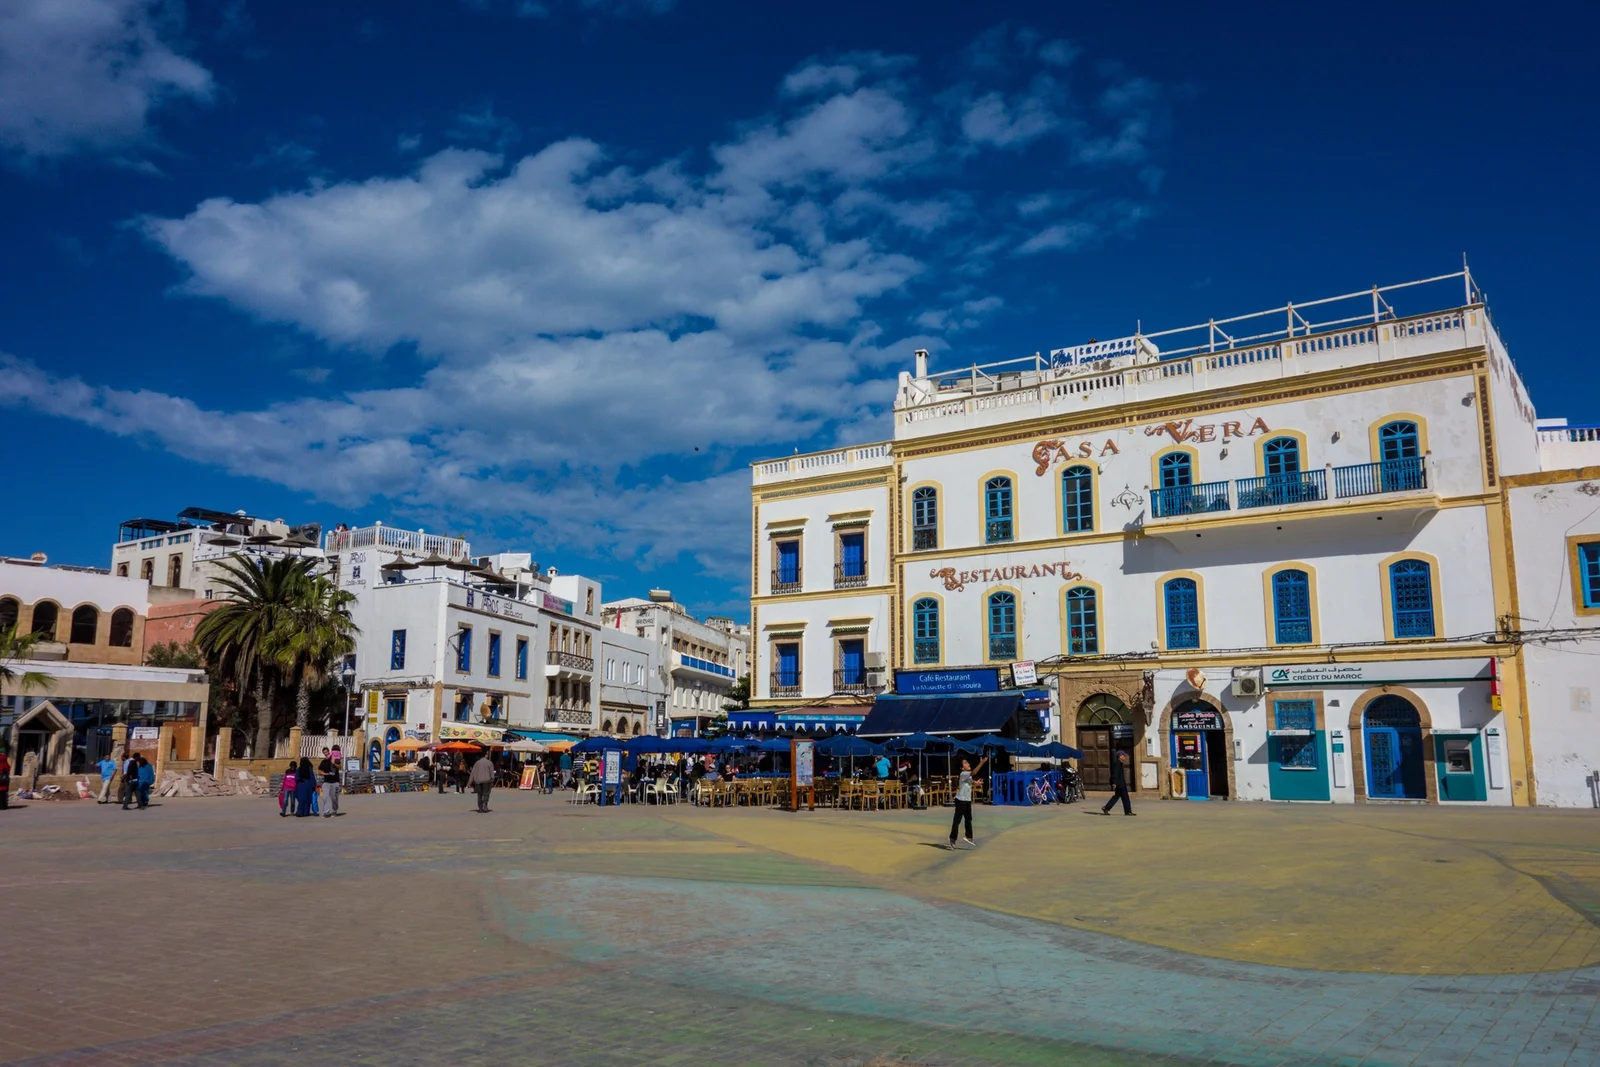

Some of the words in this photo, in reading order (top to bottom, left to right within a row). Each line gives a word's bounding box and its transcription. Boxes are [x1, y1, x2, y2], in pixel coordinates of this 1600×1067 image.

[1032, 438, 1120, 476] CASA
[1144, 416, 1270, 445] VERA
[929, 561, 1083, 592] RESTAURANT
[919, 674, 934, 682] Café
[934, 674, 971, 682] Restaurant
[1292, 673, 1320, 681] CRÉDIT
